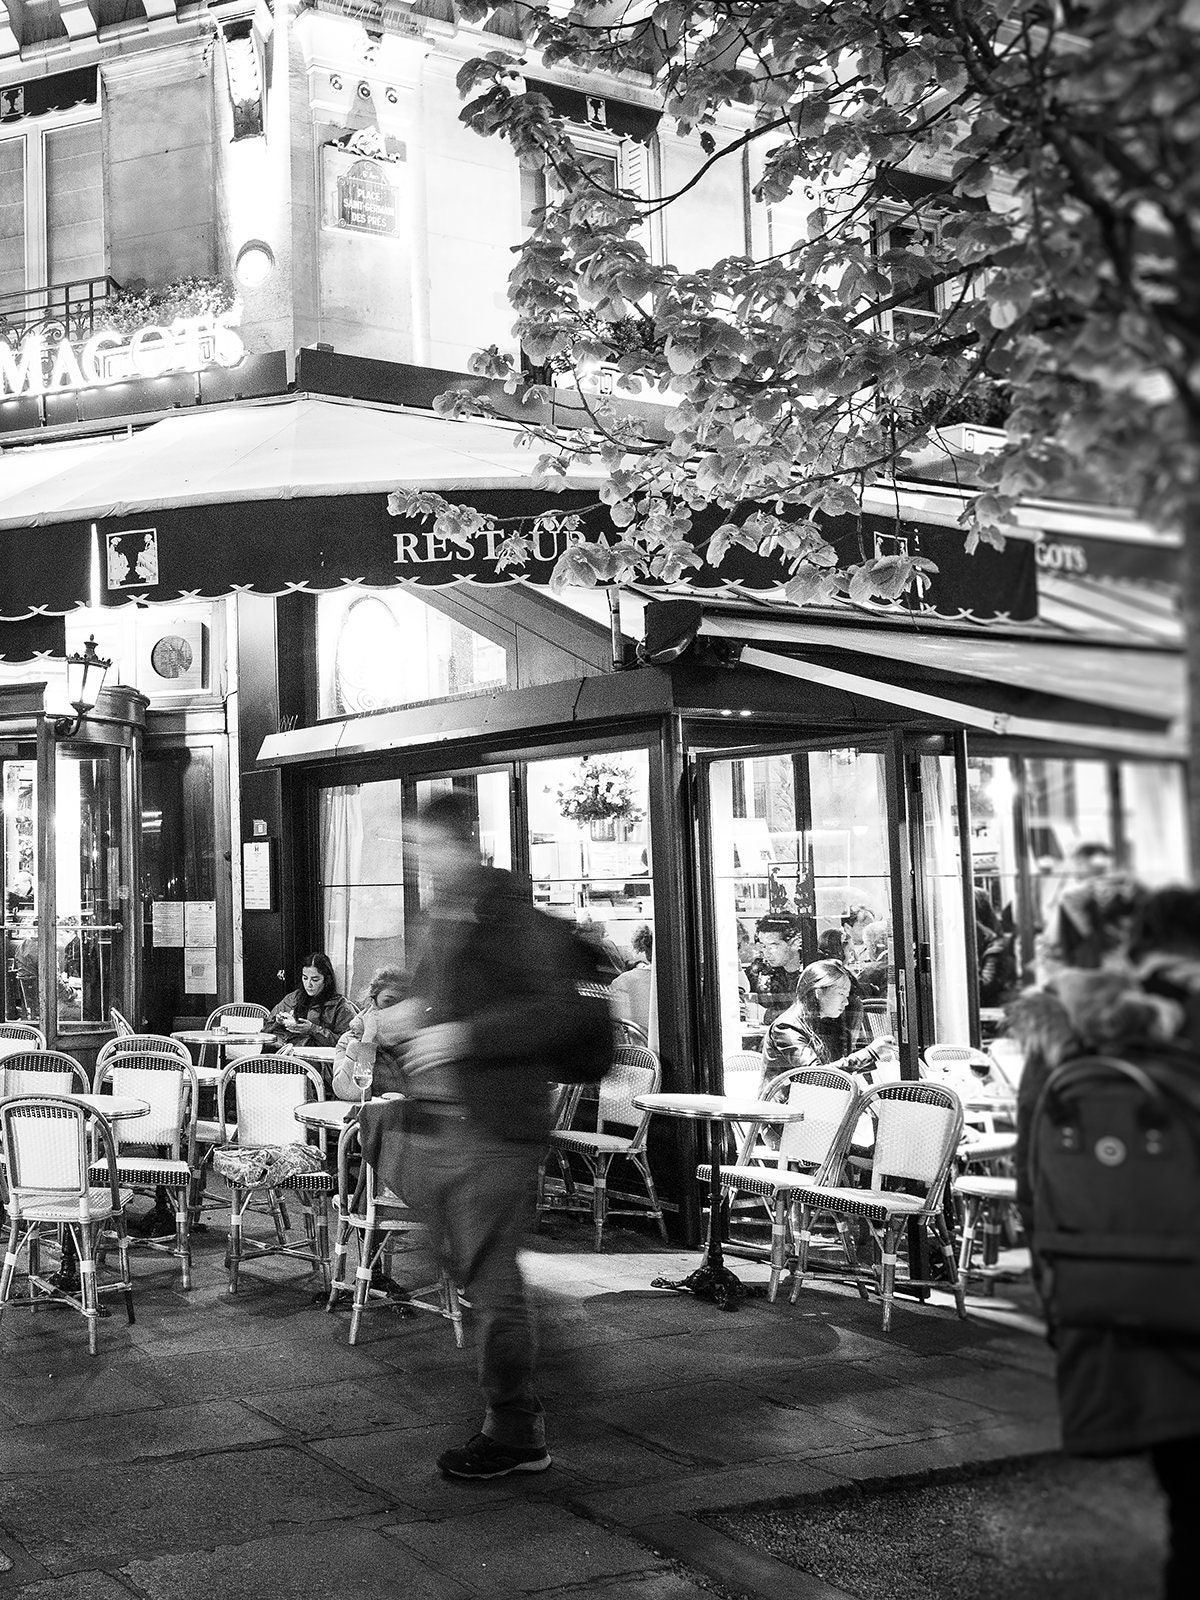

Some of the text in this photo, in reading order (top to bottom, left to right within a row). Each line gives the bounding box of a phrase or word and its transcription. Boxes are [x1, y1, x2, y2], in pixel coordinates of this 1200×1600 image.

[357, 188, 381, 202] PLACE
[351, 212, 366, 223] DES
[1035, 542, 1088, 573] GOTS
